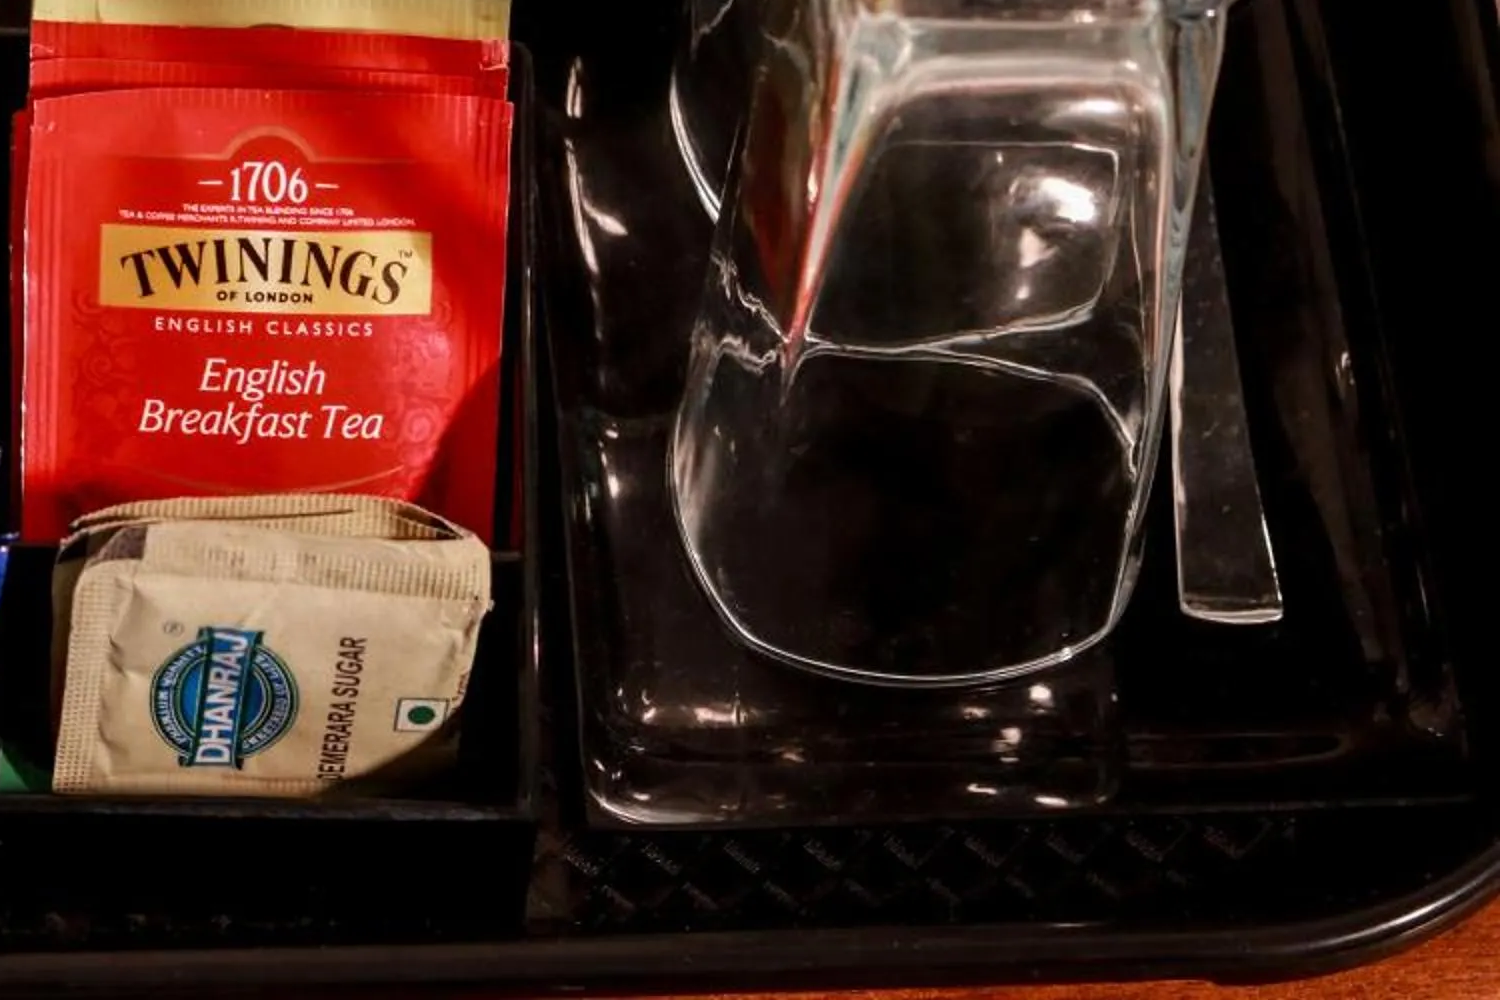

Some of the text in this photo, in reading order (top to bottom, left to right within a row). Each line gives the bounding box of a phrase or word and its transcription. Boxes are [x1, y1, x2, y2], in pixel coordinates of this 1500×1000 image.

[229, 160, 309, 204] 1706
[120, 236, 408, 305] TWININGS
[216, 290, 314, 304] OF LONDON
[154, 316, 375, 338] ENGLISH CLASSICS
[199, 356, 327, 402] English
[137, 398, 385, 446] Breakfast Tea
[194, 630, 250, 765] DHANRAJ
[316, 636, 368, 781] DEMERARA SUGAR
